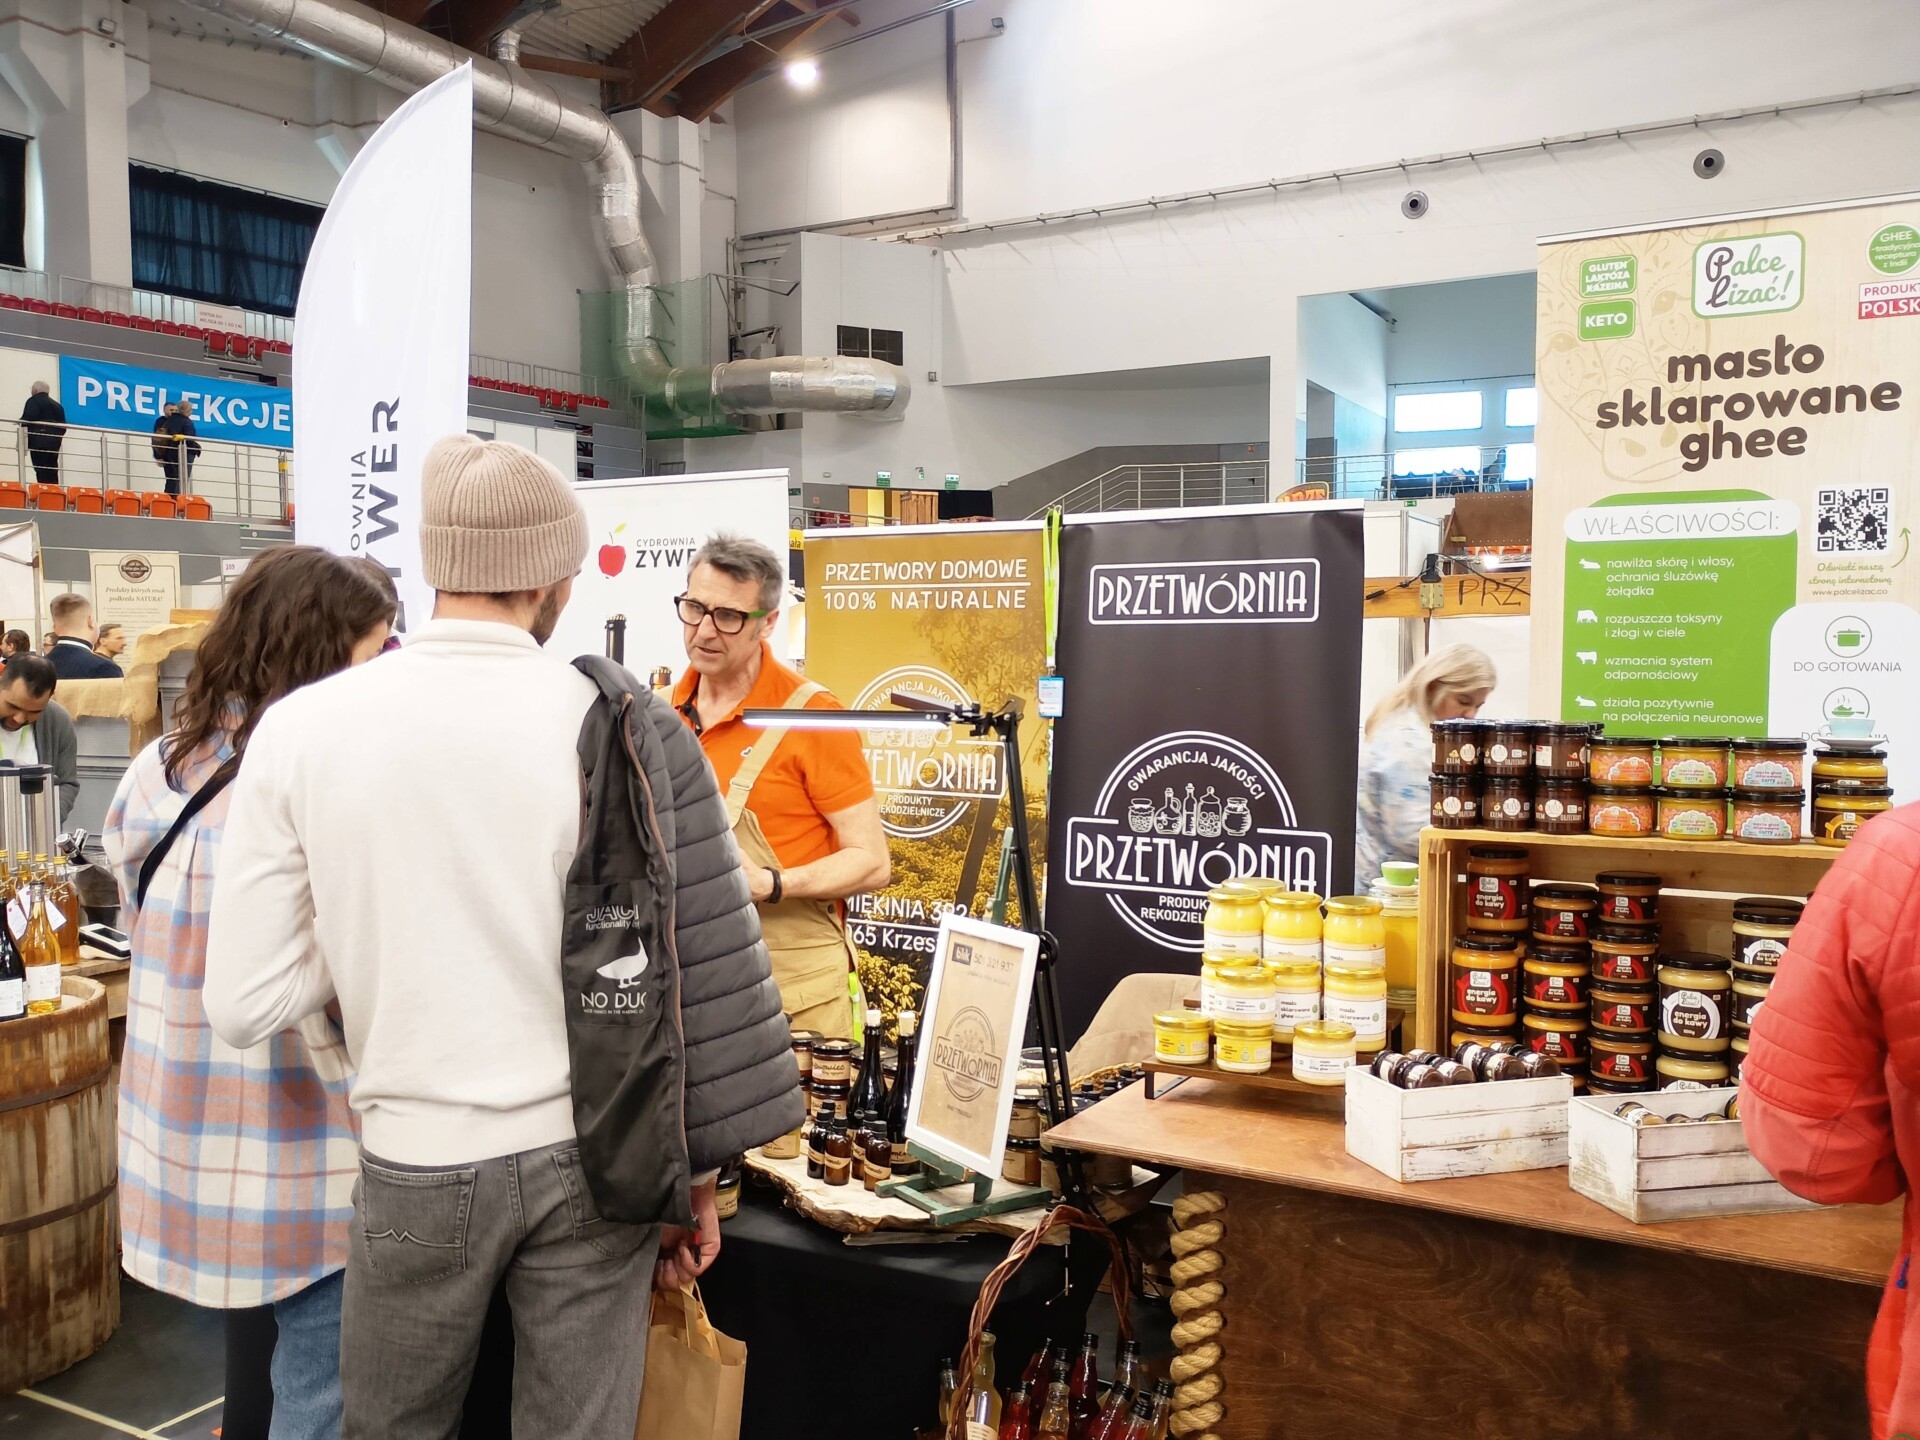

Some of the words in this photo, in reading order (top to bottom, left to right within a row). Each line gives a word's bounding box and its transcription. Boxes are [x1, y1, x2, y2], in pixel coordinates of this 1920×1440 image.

[1880, 231, 1912, 242] GHEE
[1875, 250, 1916, 260] receptura
[1588, 261, 1628, 272] GLUTEN
[1706, 243, 1786, 283] Palce
[1585, 270, 1630, 283] LAKTÓZA
[1586, 281, 1629, 292] KAZEINA
[1705, 270, 1794, 308] Lizać!
[1864, 283, 1920, 296] PRODUK
[1861, 299, 1920, 317] POLSK
[1585, 312, 1628, 328] KETO
[1668, 334, 1825, 384] masło
[1596, 382, 1903, 429] sklarowane
[1680, 419, 1808, 472] ghee
[1583, 510, 1780, 536] WŁAŚCIWOŚCI:
[636, 537, 696, 547] CYDROWNIA
[1606, 558, 1653, 569] nawilża
[1655, 556, 1688, 570] skórę
[1697, 555, 1735, 570] włosy,
[825, 561, 937, 582] PRZETWORY
[940, 559, 1028, 580] DOMOWE
[1606, 571, 1661, 583] ochrania
[1662, 570, 1719, 584] śluzówkę
[1097, 569, 1308, 616] PRZETWÓRNIA
[1458, 576, 1526, 606] PRZ
[1606, 585, 1655, 597] żołądka
[824, 591, 877, 610] 100%
[890, 589, 1027, 609] NATURALNE
[1605, 614, 1672, 626] rozpuszcza
[1675, 613, 1723, 626] toksyny
[1610, 627, 1640, 641] złogi
[1643, 630, 1653, 638] w
[1656, 628, 1686, 638] ciele
[1604, 655, 1668, 666] wzmacnia
[1670, 656, 1713, 668] system
[1793, 661, 1815, 673] DO
[1817, 661, 1903, 673] GOTOWANIA
[1604, 669, 1699, 682] odpornościowy
[1603, 697, 1641, 709] działa
[1643, 698, 1715, 711] pozytywnie
[1602, 713, 1618, 722] na
[1620, 712, 1690, 725] połączenia
[1692, 714, 1764, 724] neuronowe
[862, 748, 997, 791] ETWÓRNIA
[1127, 750, 1209, 792] GWARANCJA
[1210, 755, 1266, 800] JAKOŚCI
[887, 794, 933, 806] PRODUKTY
[1076, 832, 1317, 893] PRZETWÓRNIA
[1159, 895, 1210, 910] PRODUK
[1476, 893, 1504, 902] energia
[1485, 900, 1504, 909] kawy
[1141, 908, 1205, 924] RĘKODZIEL
[585, 918, 632, 931] functionality
[882, 928, 938, 953] Krzes
[1466, 987, 1496, 998] energia
[1466, 994, 1474, 1002] do
[1477, 995, 1497, 1005] kawy
[581, 992, 608, 1008] NO
[1674, 1010, 1707, 1021] energia
[1684, 1018, 1708, 1029] kawy
